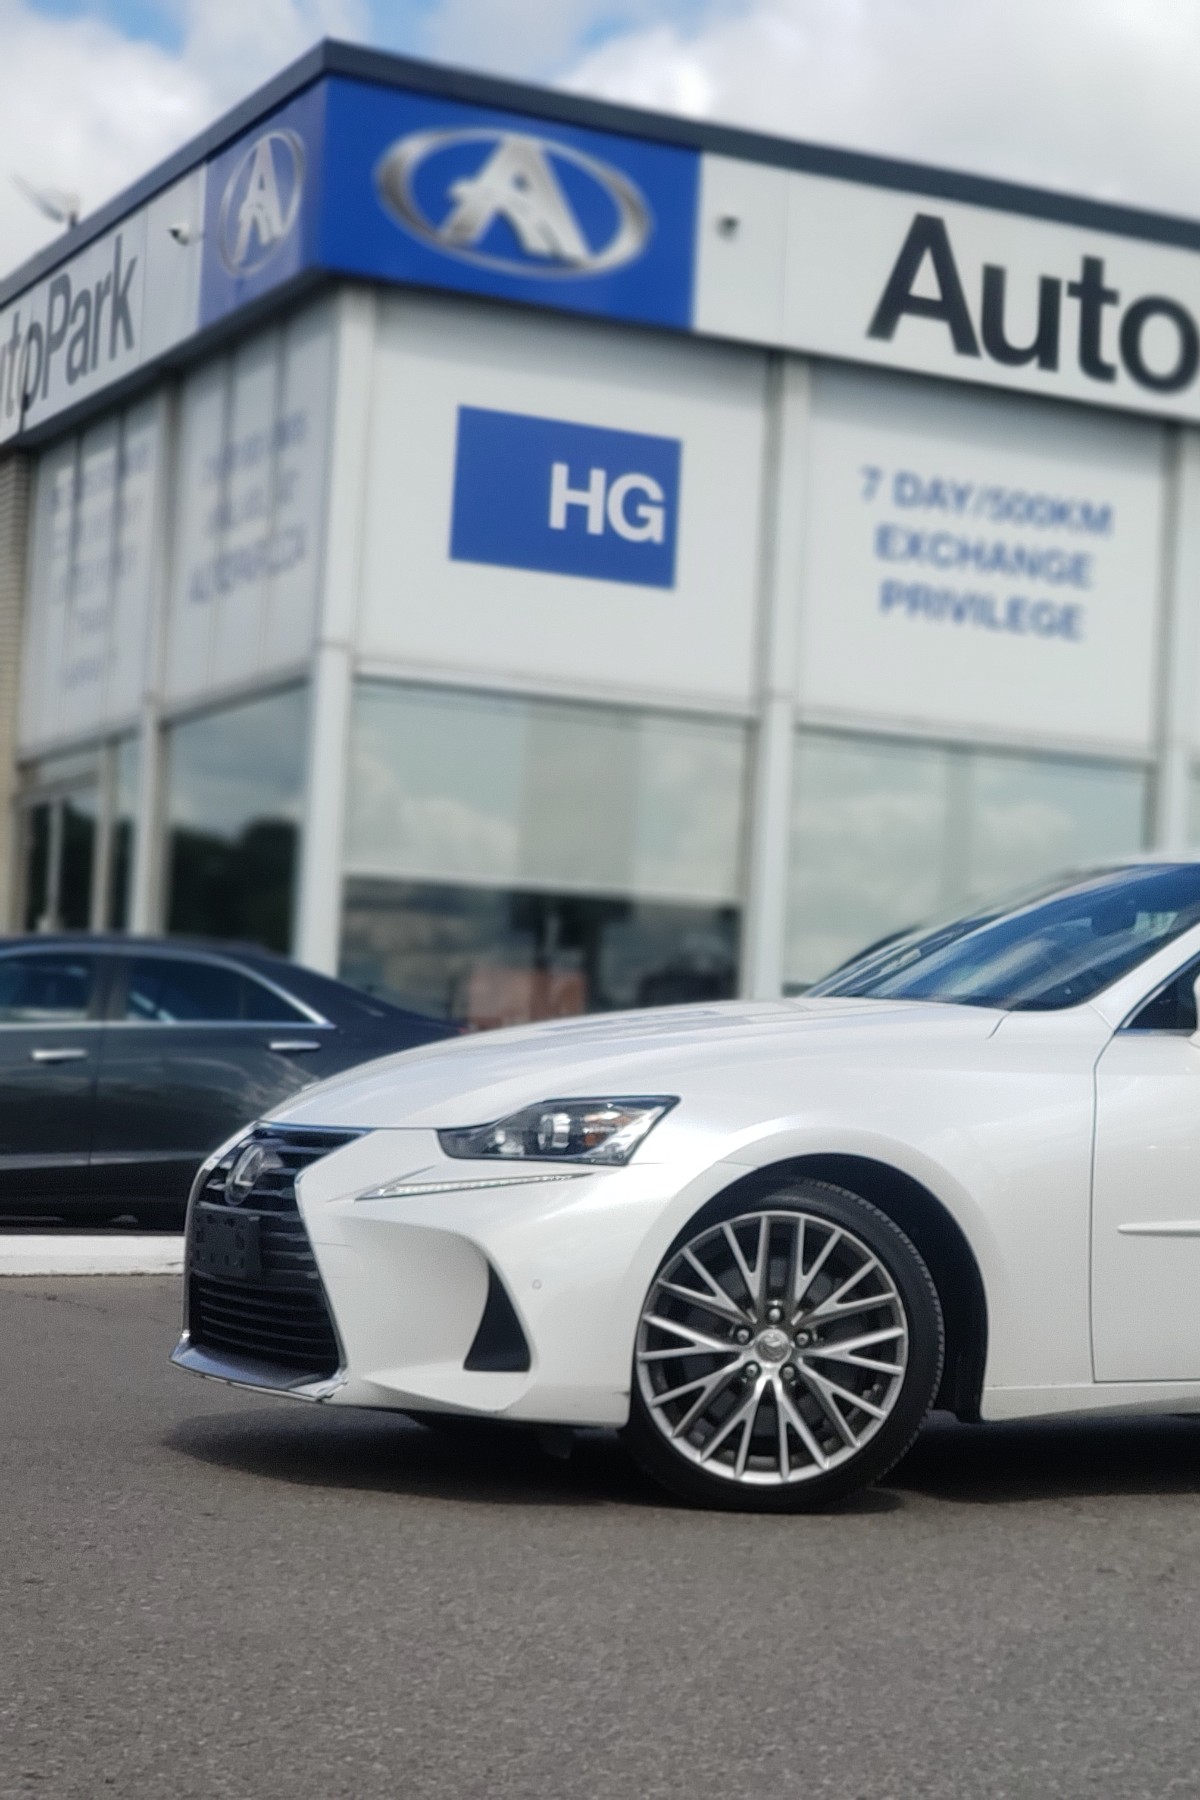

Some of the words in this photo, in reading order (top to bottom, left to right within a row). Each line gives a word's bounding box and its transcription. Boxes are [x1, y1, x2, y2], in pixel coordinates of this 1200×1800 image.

[549, 463, 665, 543] HG
[860, 464, 883, 502] 7
[875, 521, 1093, 590] EXCHANGE
[879, 578, 1084, 642] PRIVILEGE
